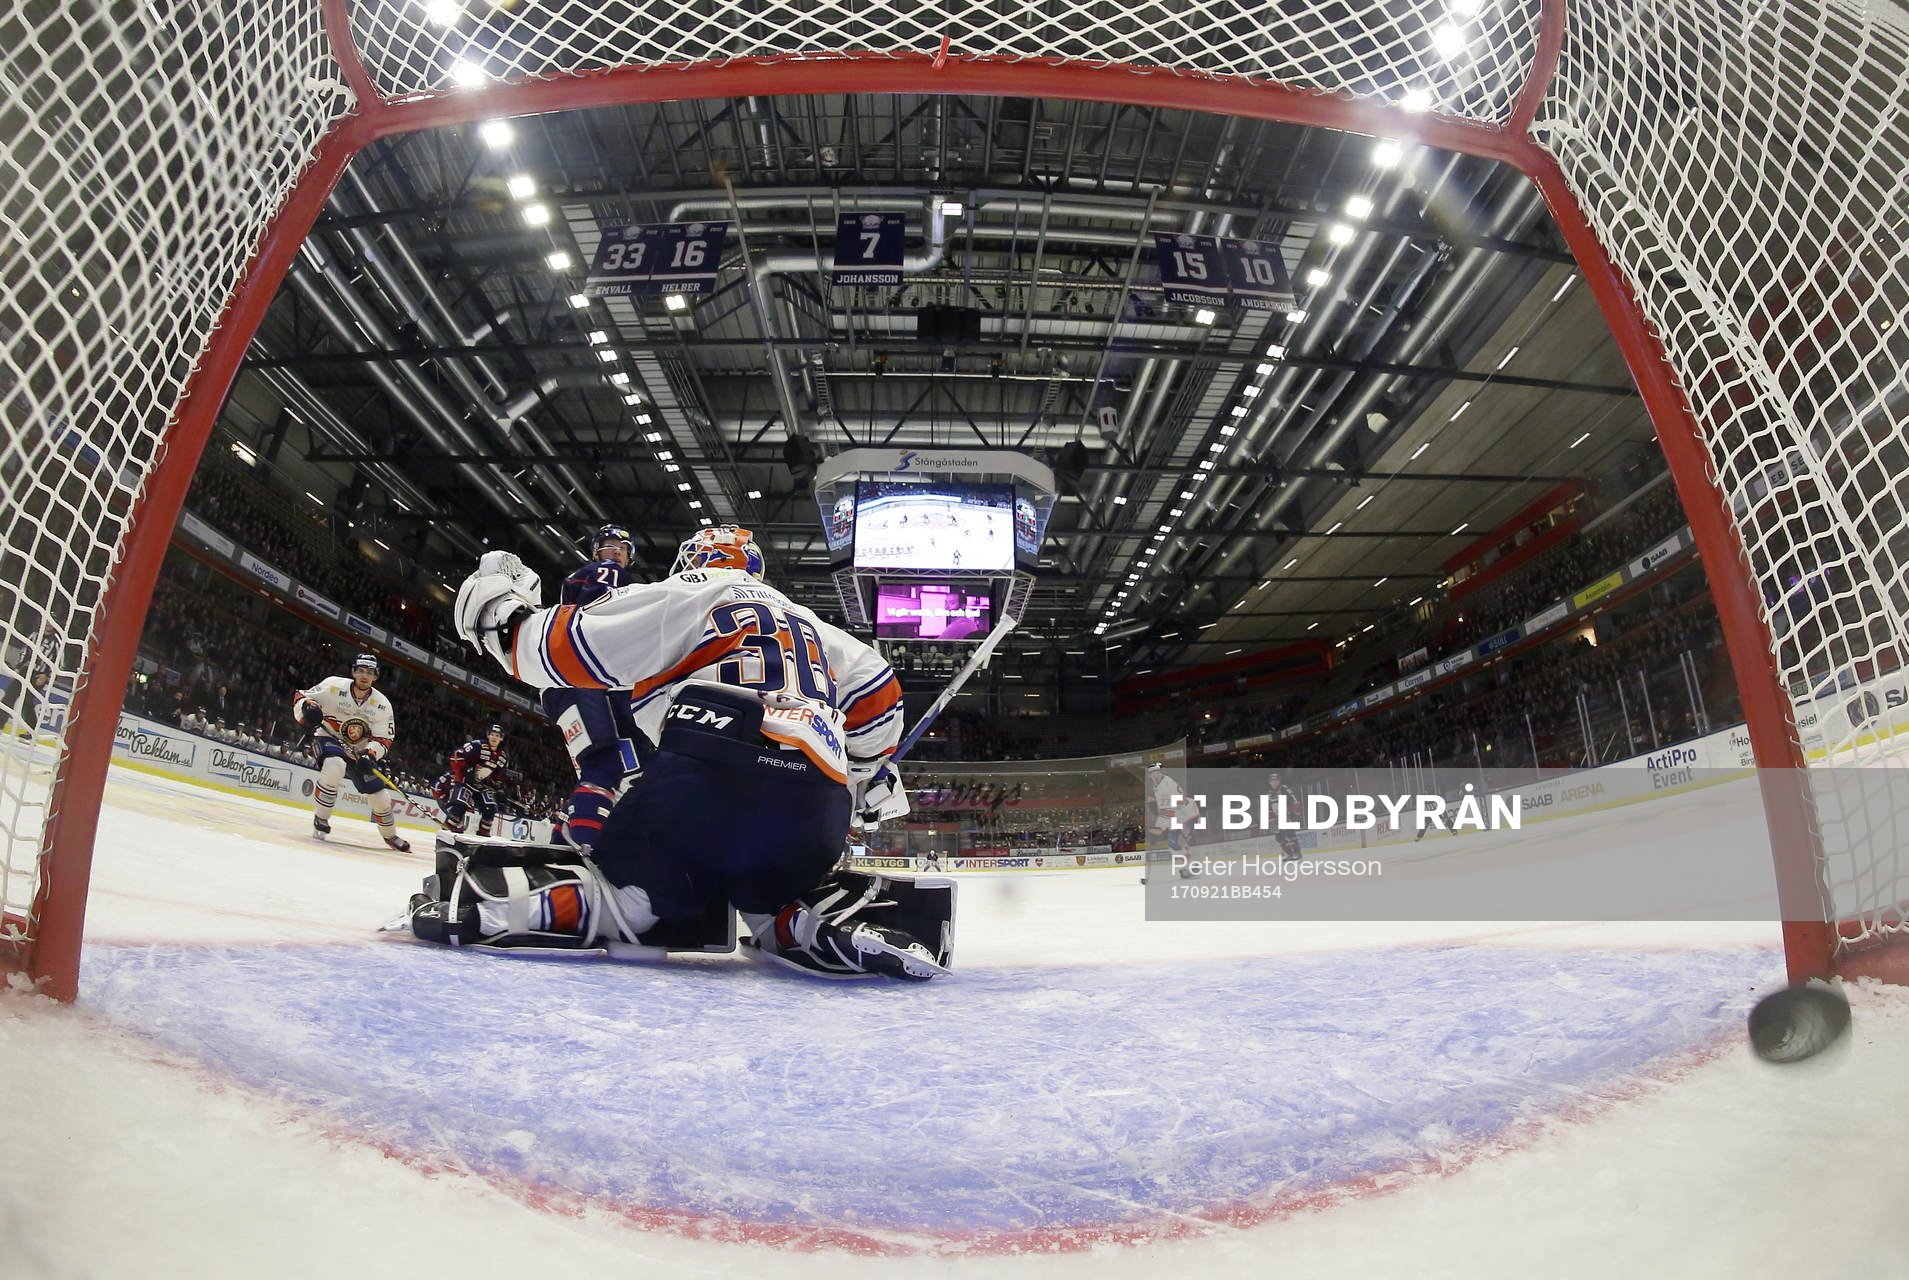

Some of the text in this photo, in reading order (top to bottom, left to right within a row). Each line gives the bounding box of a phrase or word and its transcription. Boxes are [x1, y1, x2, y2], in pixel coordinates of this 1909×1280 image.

[602, 243, 647, 270] 33
[670, 240, 708, 267] 16
[860, 232, 881, 258] 7
[1173, 251, 1208, 280] 15
[1240, 257, 1276, 286] 10
[661, 282, 701, 292] HELBER
[837, 274, 899, 284] JOHANSSON
[1170, 292, 1225, 306] JACOBSSON
[251, 562, 279, 584] Nordea
[597, 567, 619, 587] 21
[679, 573, 709, 583] GBJ
[707, 600, 839, 710] 30
[666, 704, 734, 730] CCM
[763, 704, 843, 760] NTERSPORT
[131, 734, 181, 764] Reklam
[212, 748, 244, 773] Dekor
[757, 756, 807, 771] PREMIER
[1647, 748, 1697, 774] ActiPro
[241, 766, 281, 788] Reklam
[1652, 766, 1694, 790] Event
[1521, 793, 1554, 810] SAAB
[1560, 781, 1606, 803] ARENA
[856, 859, 905, 867] XL-BYGG
[965, 858, 1030, 868] INTERSPORT
